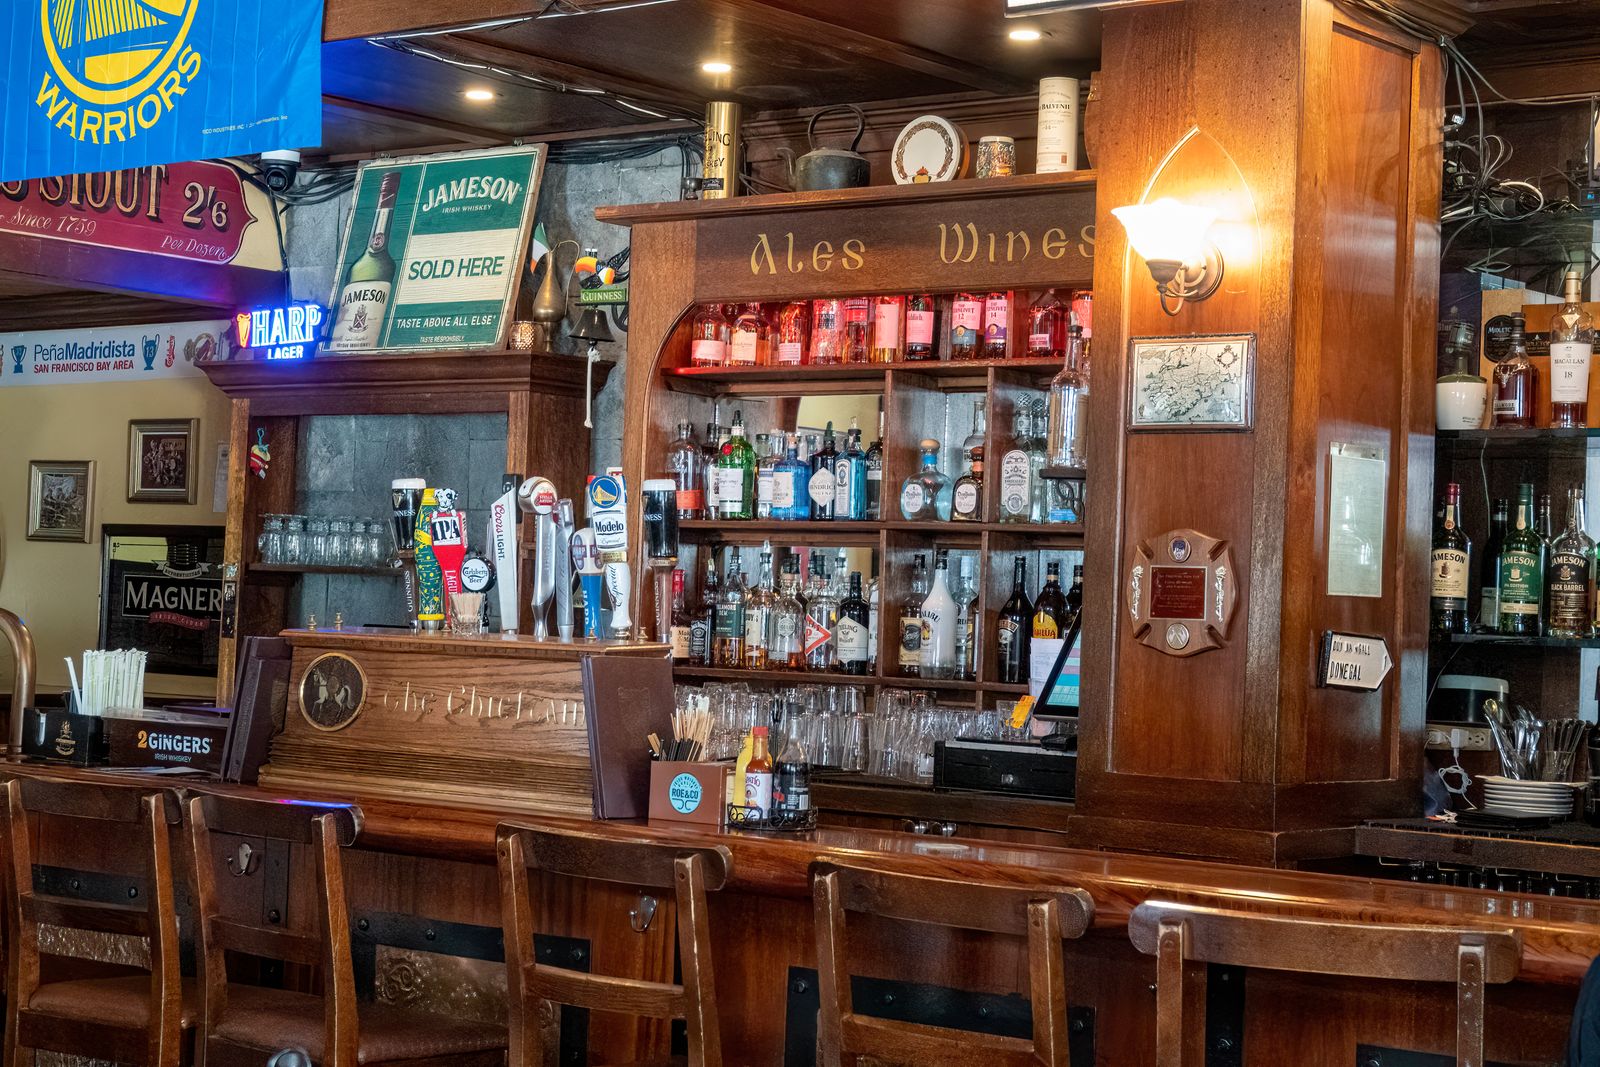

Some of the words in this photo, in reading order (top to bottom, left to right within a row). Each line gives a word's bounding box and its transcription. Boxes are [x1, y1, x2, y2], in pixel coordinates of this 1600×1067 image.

[35, 44, 202, 145] WARRIORS
[422, 175, 520, 212] JAMESON
[462, 204, 492, 212] WHISKEY
[7, 206, 52, 230] Since
[56, 216, 97, 236] 1759
[750, 231, 866, 275] Ales
[938, 221, 1096, 264] Wines
[408, 259, 455, 281] SOLD
[457, 256, 505, 277] HERE
[342, 289, 388, 308] JAMESON
[582, 290, 622, 301] GUINNESS
[250, 304, 322, 348] HARP
[396, 318, 422, 329] TASTE
[423, 316, 452, 328] ABOVE
[452, 316, 468, 326] ALL
[267, 345, 304, 360] LAGER
[33, 364, 49, 374] SAN
[51, 362, 94, 373] FRANCISCO
[96, 361, 111, 371] BAY
[112, 360, 134, 370] AREA
[1564, 371, 1573, 379] 18
[494, 503, 506, 533] Coors
[594, 520, 624, 533] Modelo
[430, 519, 461, 541] IPA
[496, 533, 505, 559] LIGHT
[462, 566, 488, 577] Carlsberg
[404, 570, 413, 613] GUINNESS
[1563, 583, 1585, 592] BARREL
[1329, 660, 1361, 681] DONEGAL
[384, 681, 437, 712] The
[137, 729, 147, 749] 2
[154, 753, 168, 761] IRISH
[168, 754, 192, 763] WHISKEY
[671, 788, 699, 800] ROE&CO
